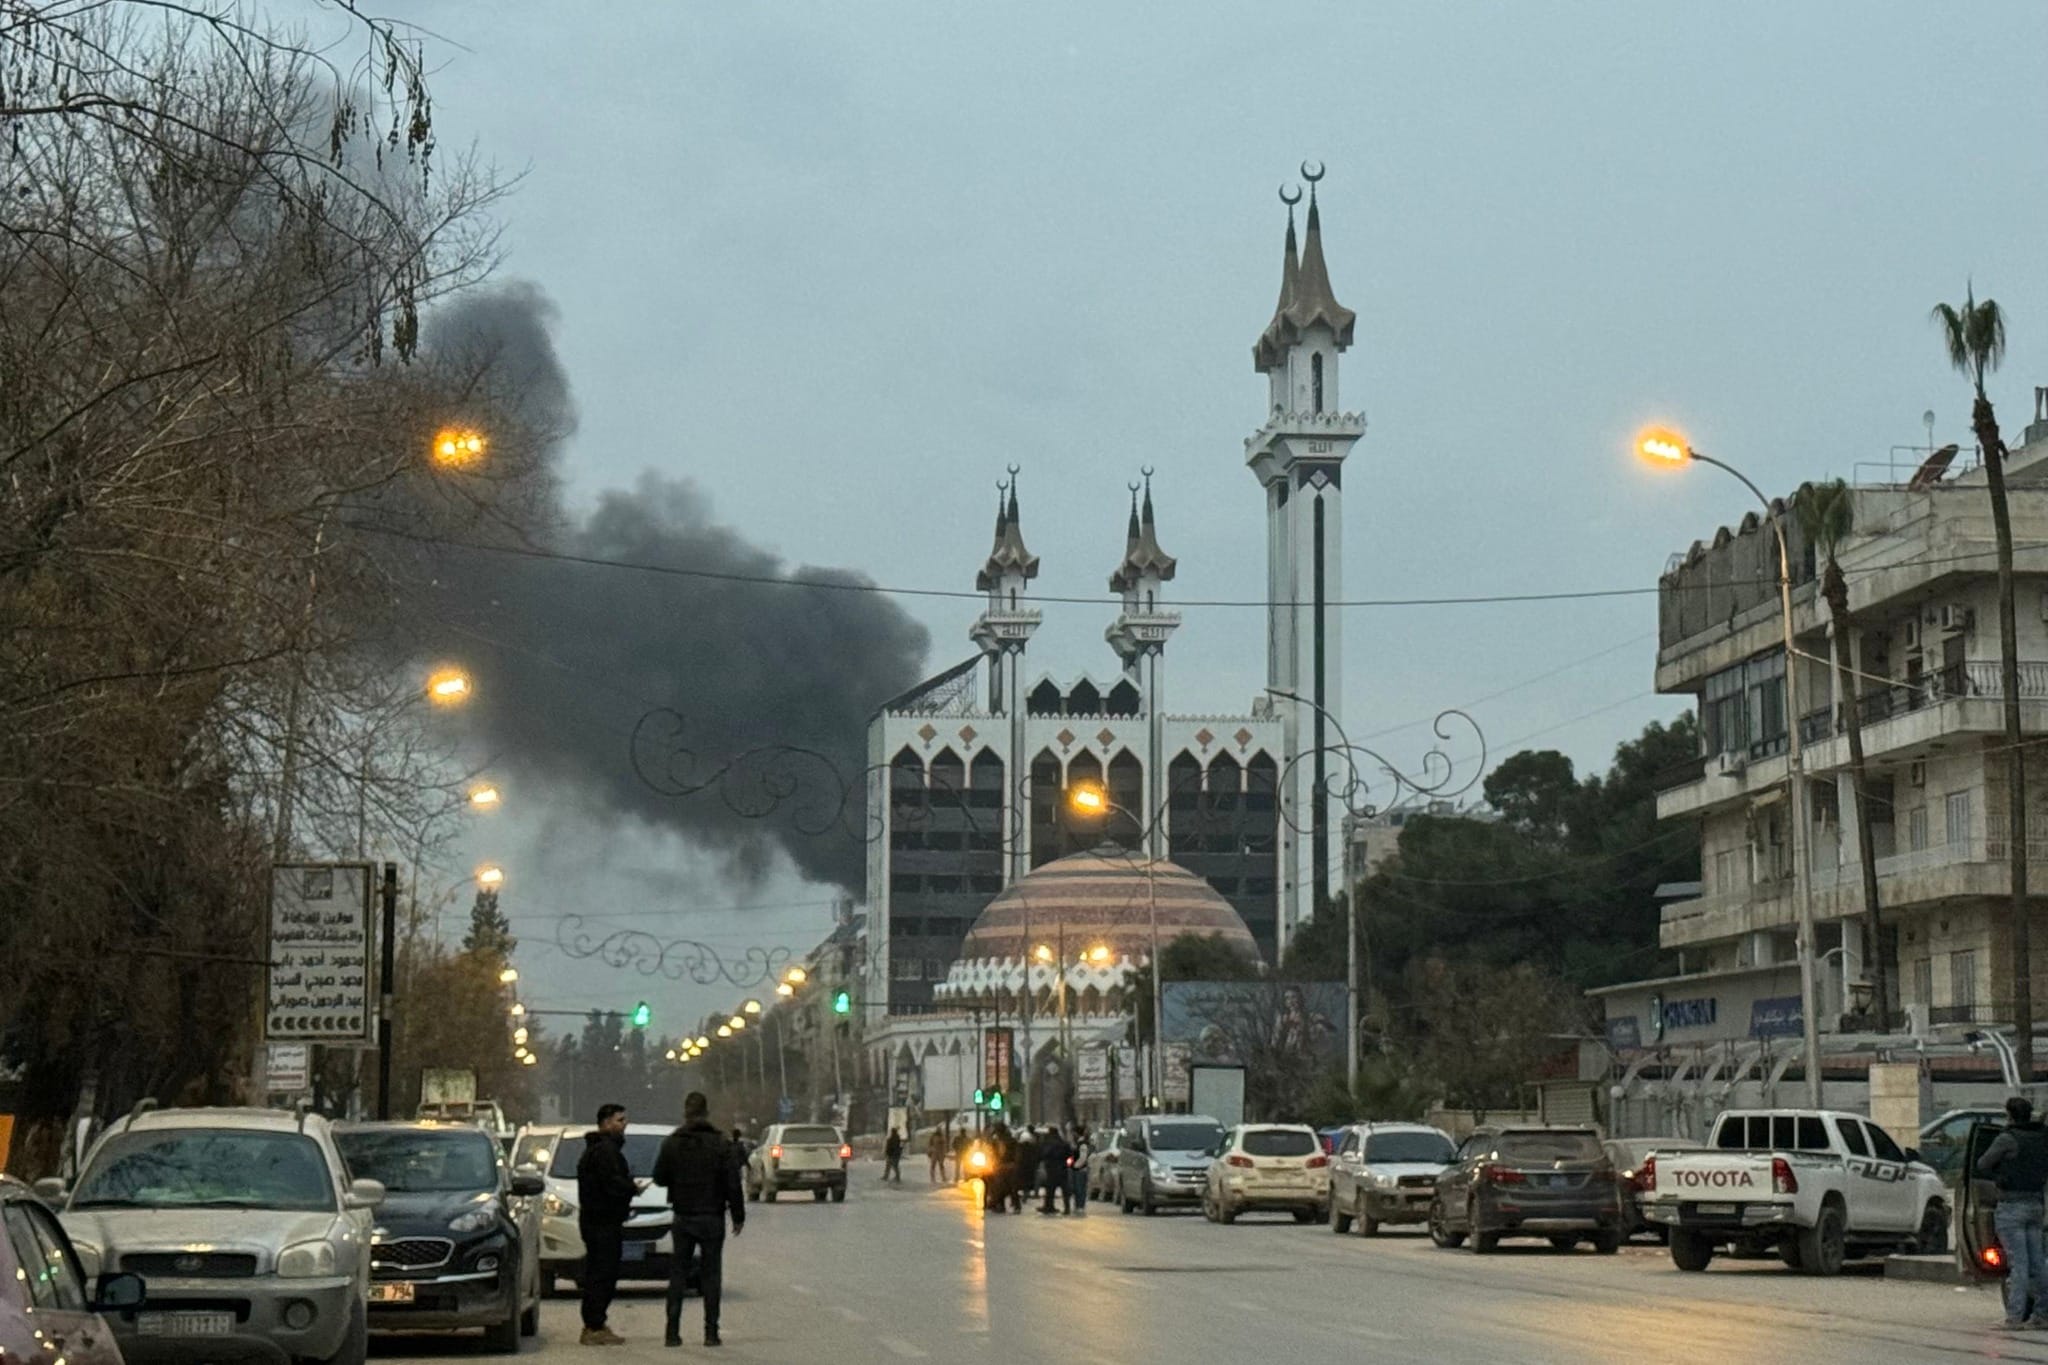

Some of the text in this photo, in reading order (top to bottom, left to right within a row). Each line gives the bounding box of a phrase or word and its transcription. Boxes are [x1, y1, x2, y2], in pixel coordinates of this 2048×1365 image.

[1308, 441, 1333, 453] الله
[1002, 625, 1026, 637] الله
[1141, 626, 1165, 638] الله
[299, 950, 325, 967] أحمد
[329, 955, 364, 968] محمود
[273, 972, 363, 992] محمد صبحي السيد
[310, 993, 343, 1009] الرحمن
[345, 995, 363, 1008] عبد
[1671, 1170, 1753, 1187] TOYOTA
